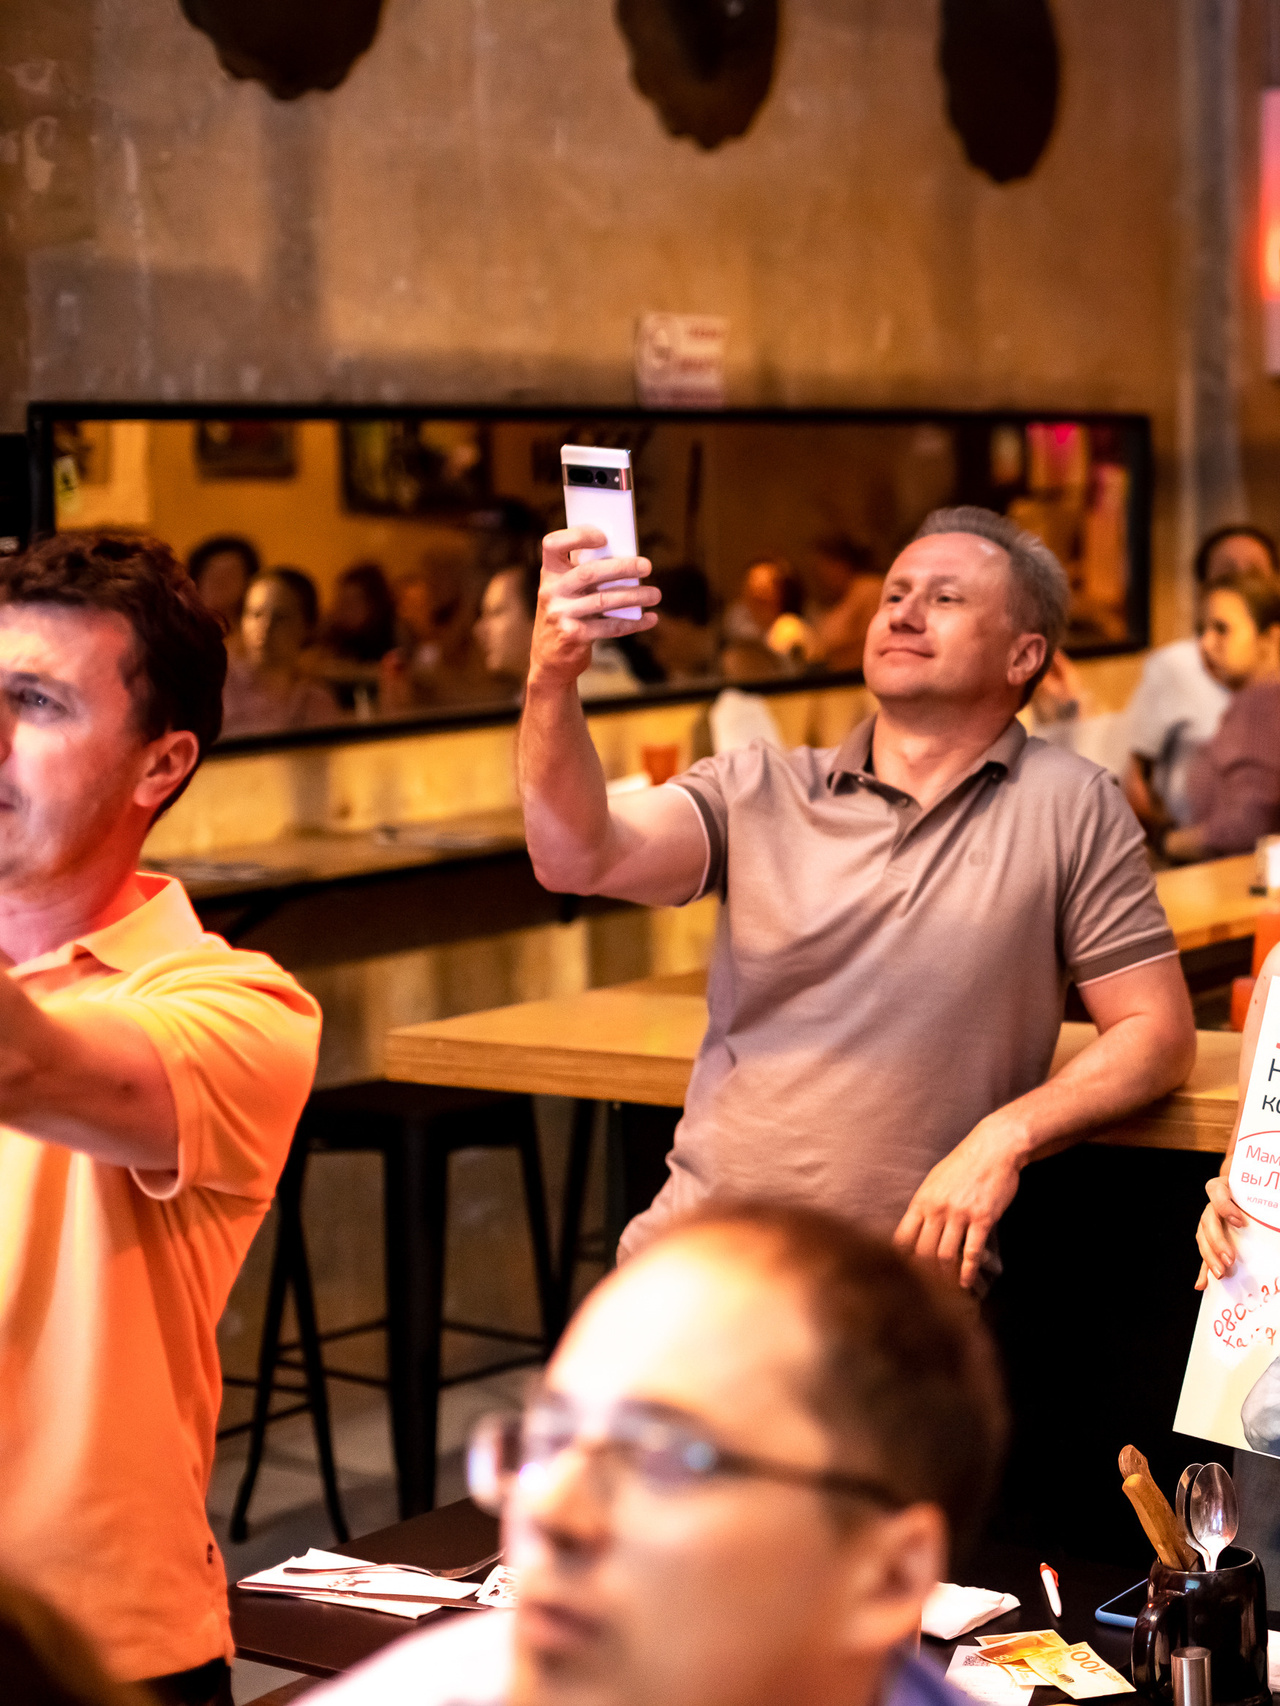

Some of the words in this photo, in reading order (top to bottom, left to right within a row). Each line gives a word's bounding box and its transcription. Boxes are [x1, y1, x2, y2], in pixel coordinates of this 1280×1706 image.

[1240, 1171, 1263, 1187] вы
[1246, 1195, 1279, 1209] клятва
[1070, 1650, 1105, 1675] 100
